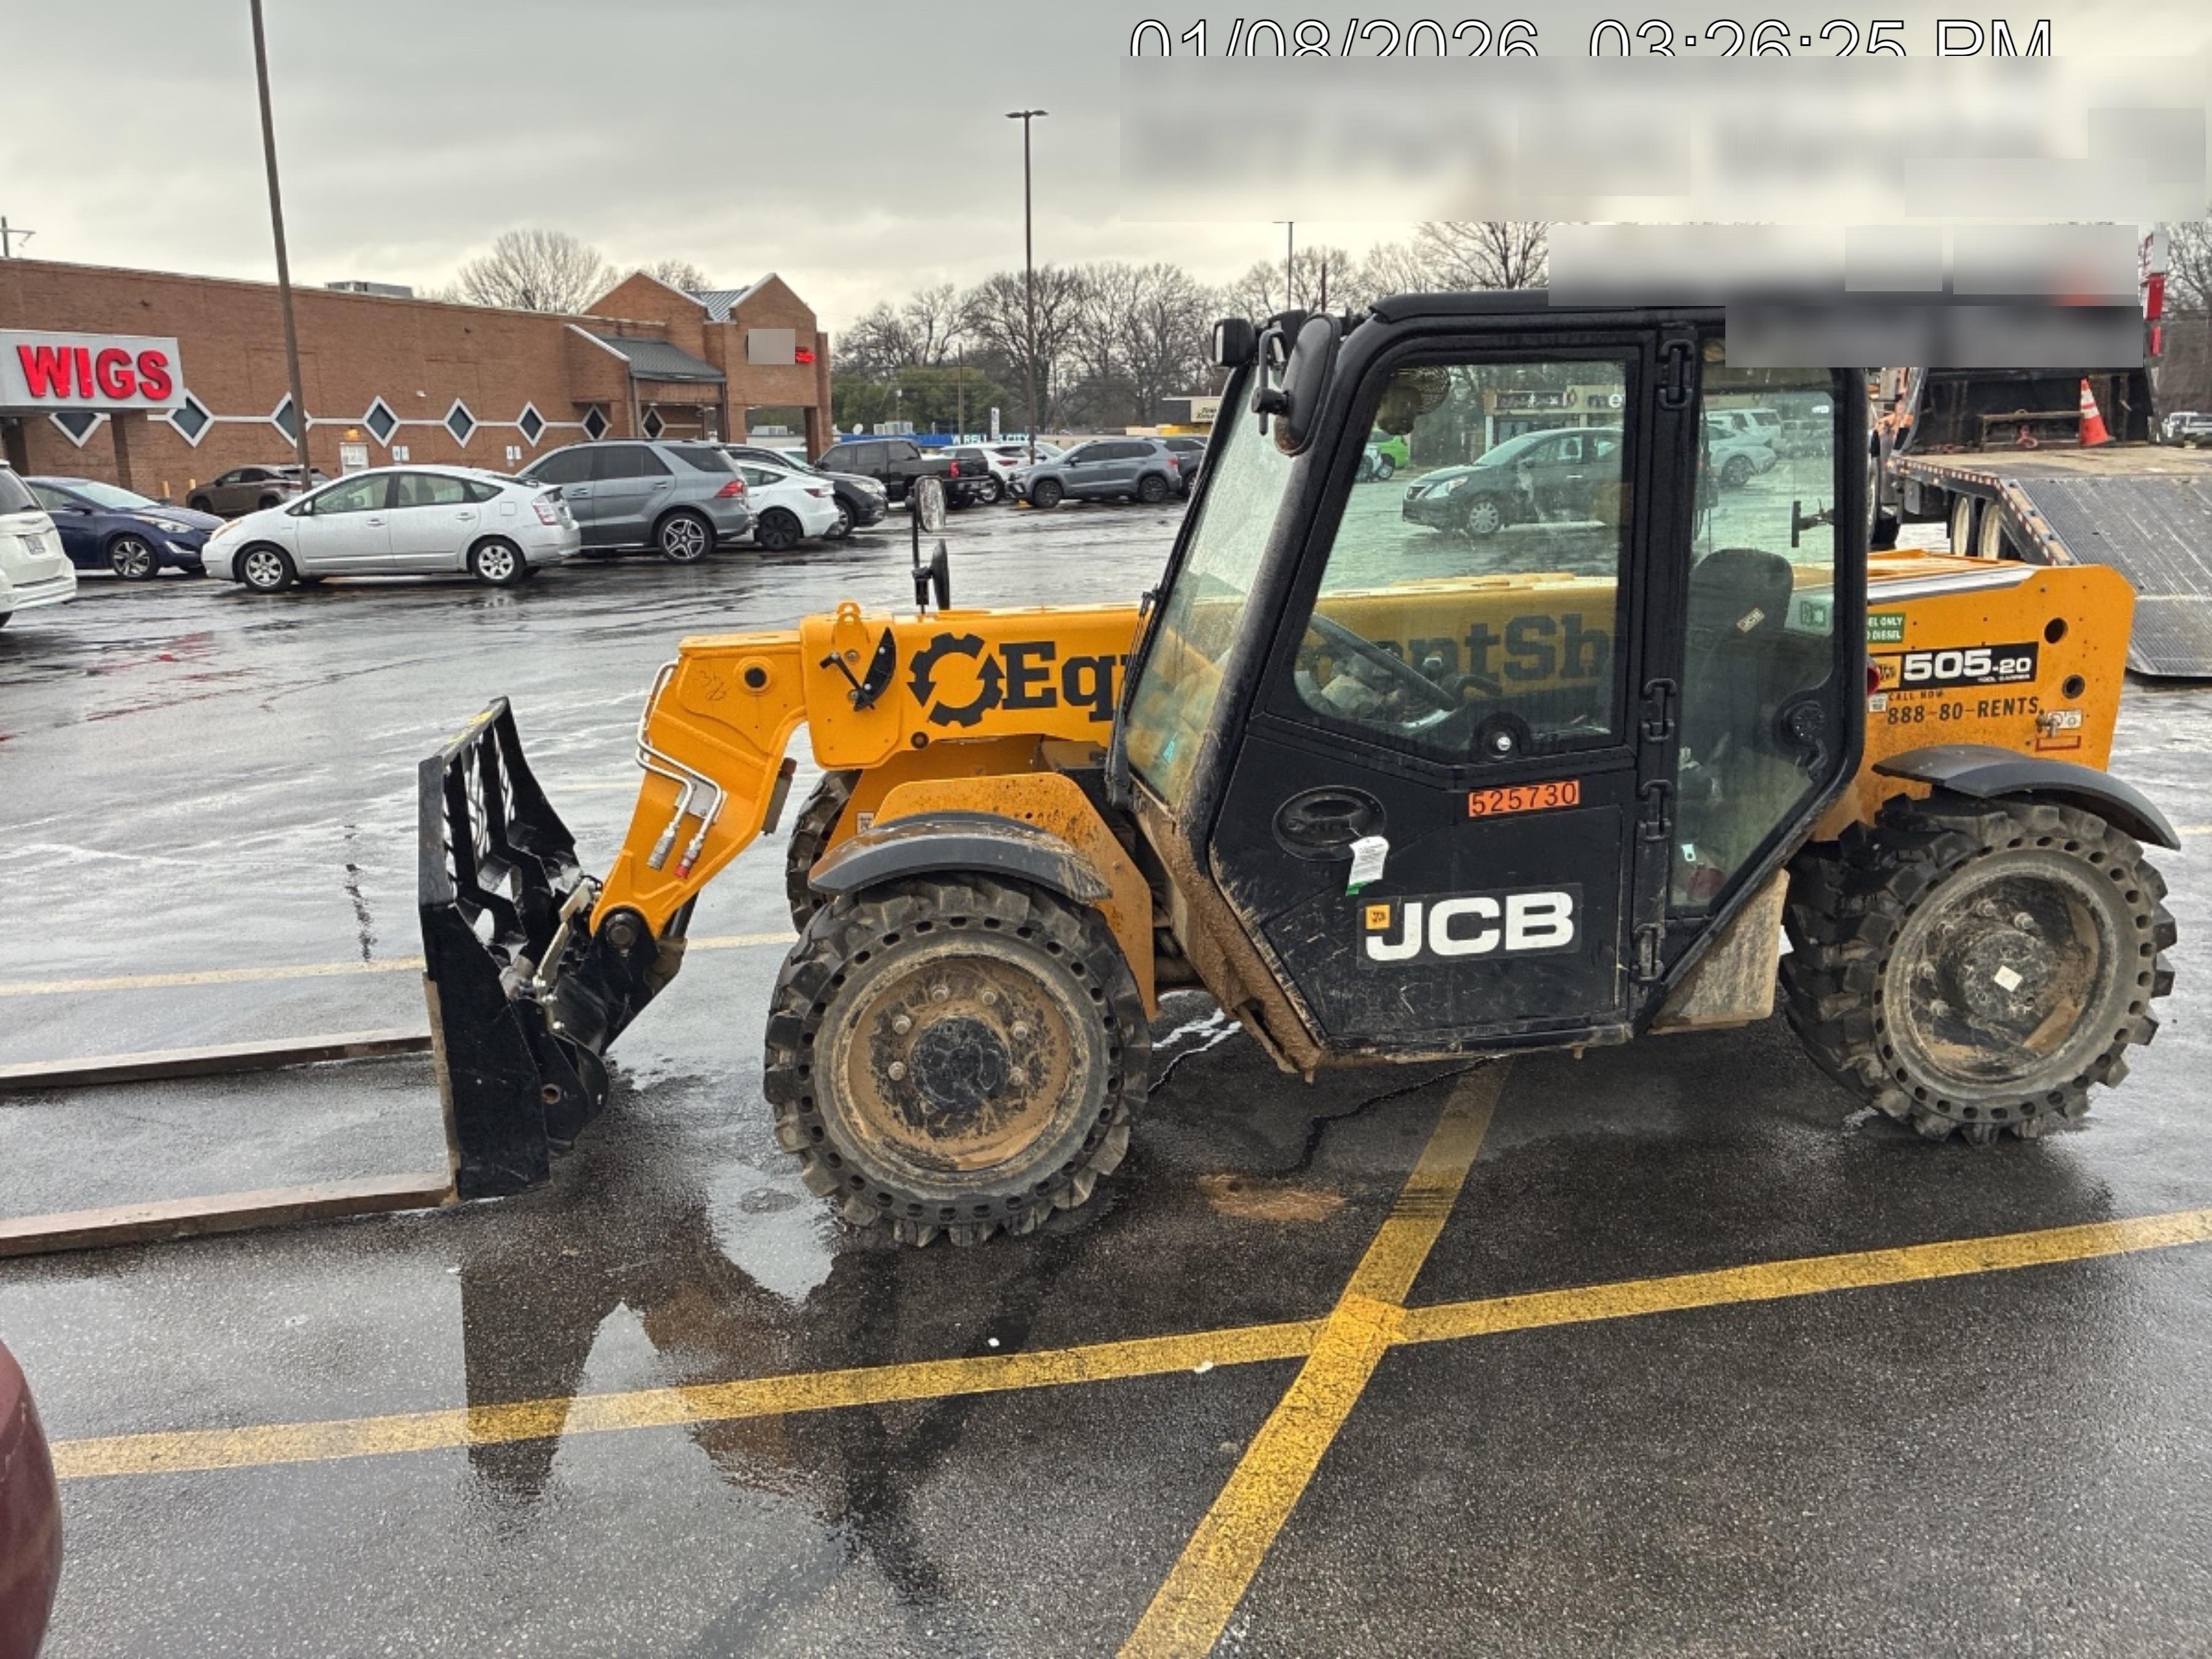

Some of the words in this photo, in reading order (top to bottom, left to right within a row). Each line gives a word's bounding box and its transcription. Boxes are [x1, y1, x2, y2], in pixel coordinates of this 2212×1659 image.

[17, 344, 172, 400] WIGS
[1880, 616, 1903, 626] ONLY
[999, 641, 1131, 723] Eq
[1888, 691, 1915, 702] CALL
[1920, 688, 1943, 699] NOW
[1472, 782, 1577, 815] 525730
[1365, 892, 1574, 962] JCB
